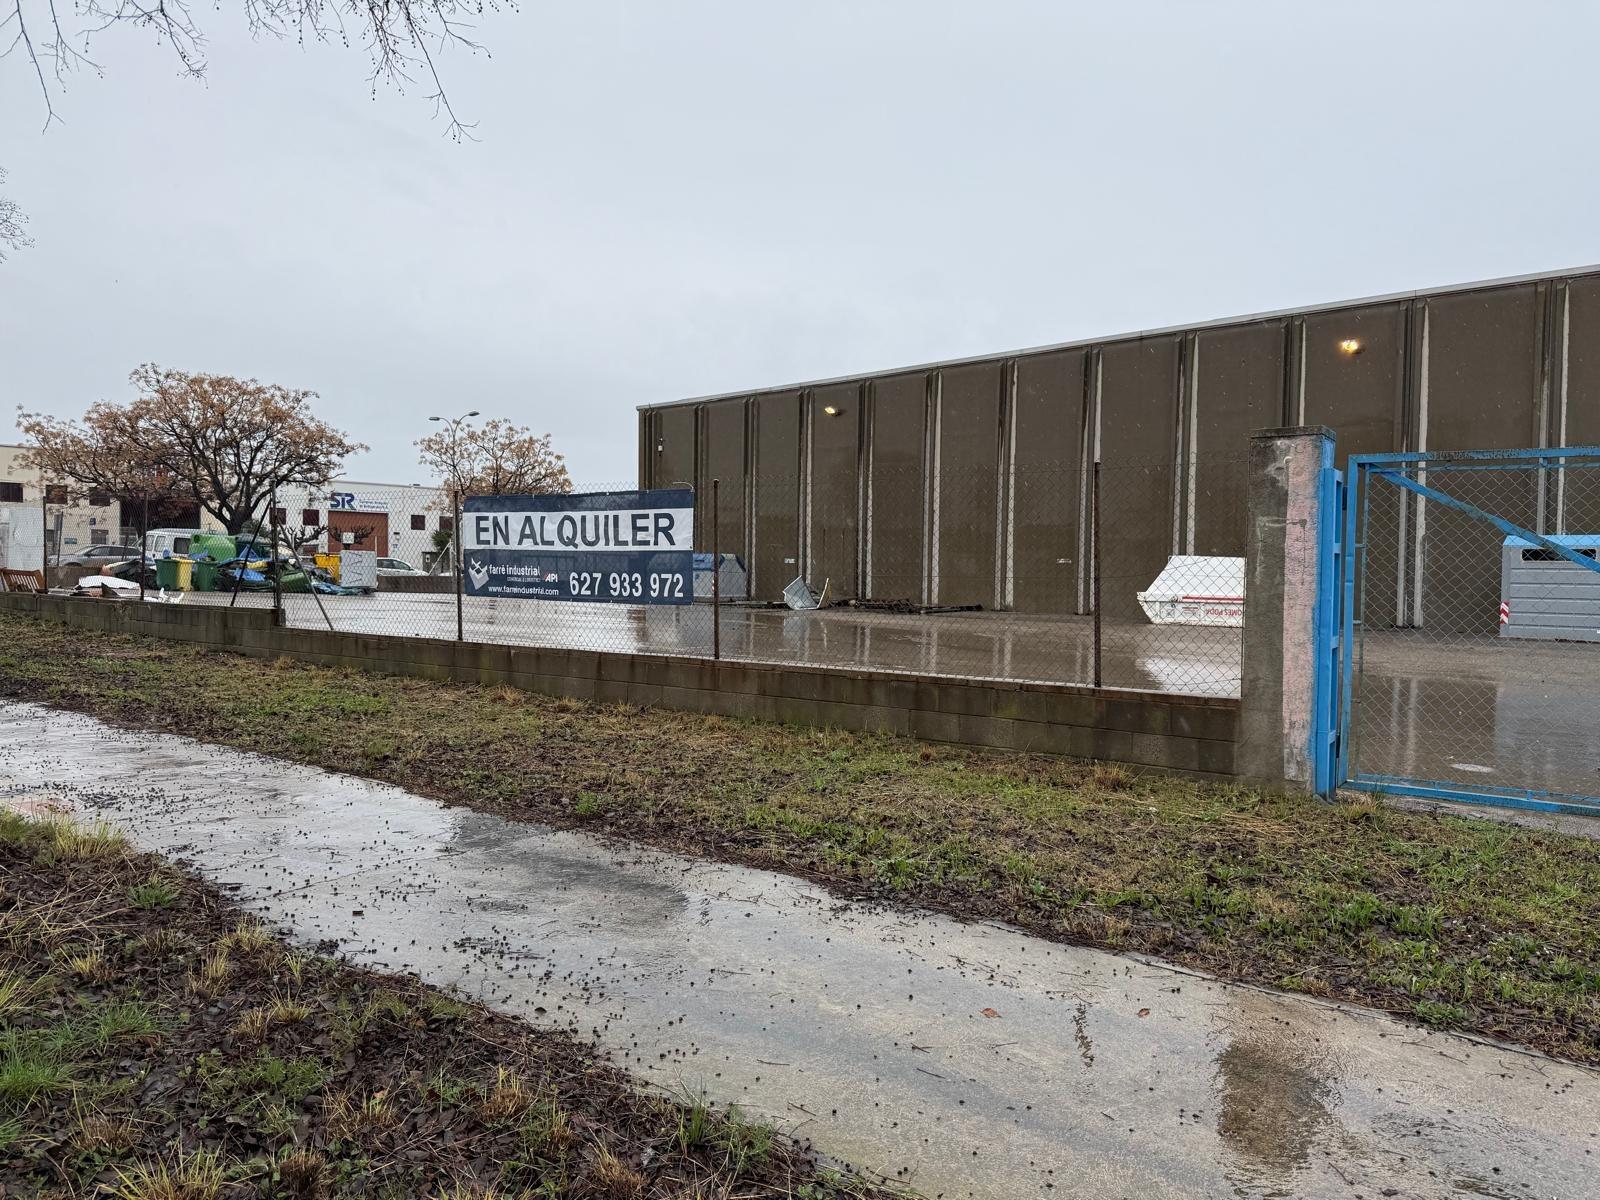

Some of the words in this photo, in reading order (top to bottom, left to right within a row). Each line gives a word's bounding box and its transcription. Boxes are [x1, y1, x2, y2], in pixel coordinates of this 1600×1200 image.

[475, 515, 509, 546] EN
[517, 512, 676, 549] ALQUILER
[506, 564, 540, 576] industrial
[545, 573, 559, 583] API
[569, 572, 602, 596] 627
[609, 573, 642, 597] 933
[649, 573, 684, 598] 972
